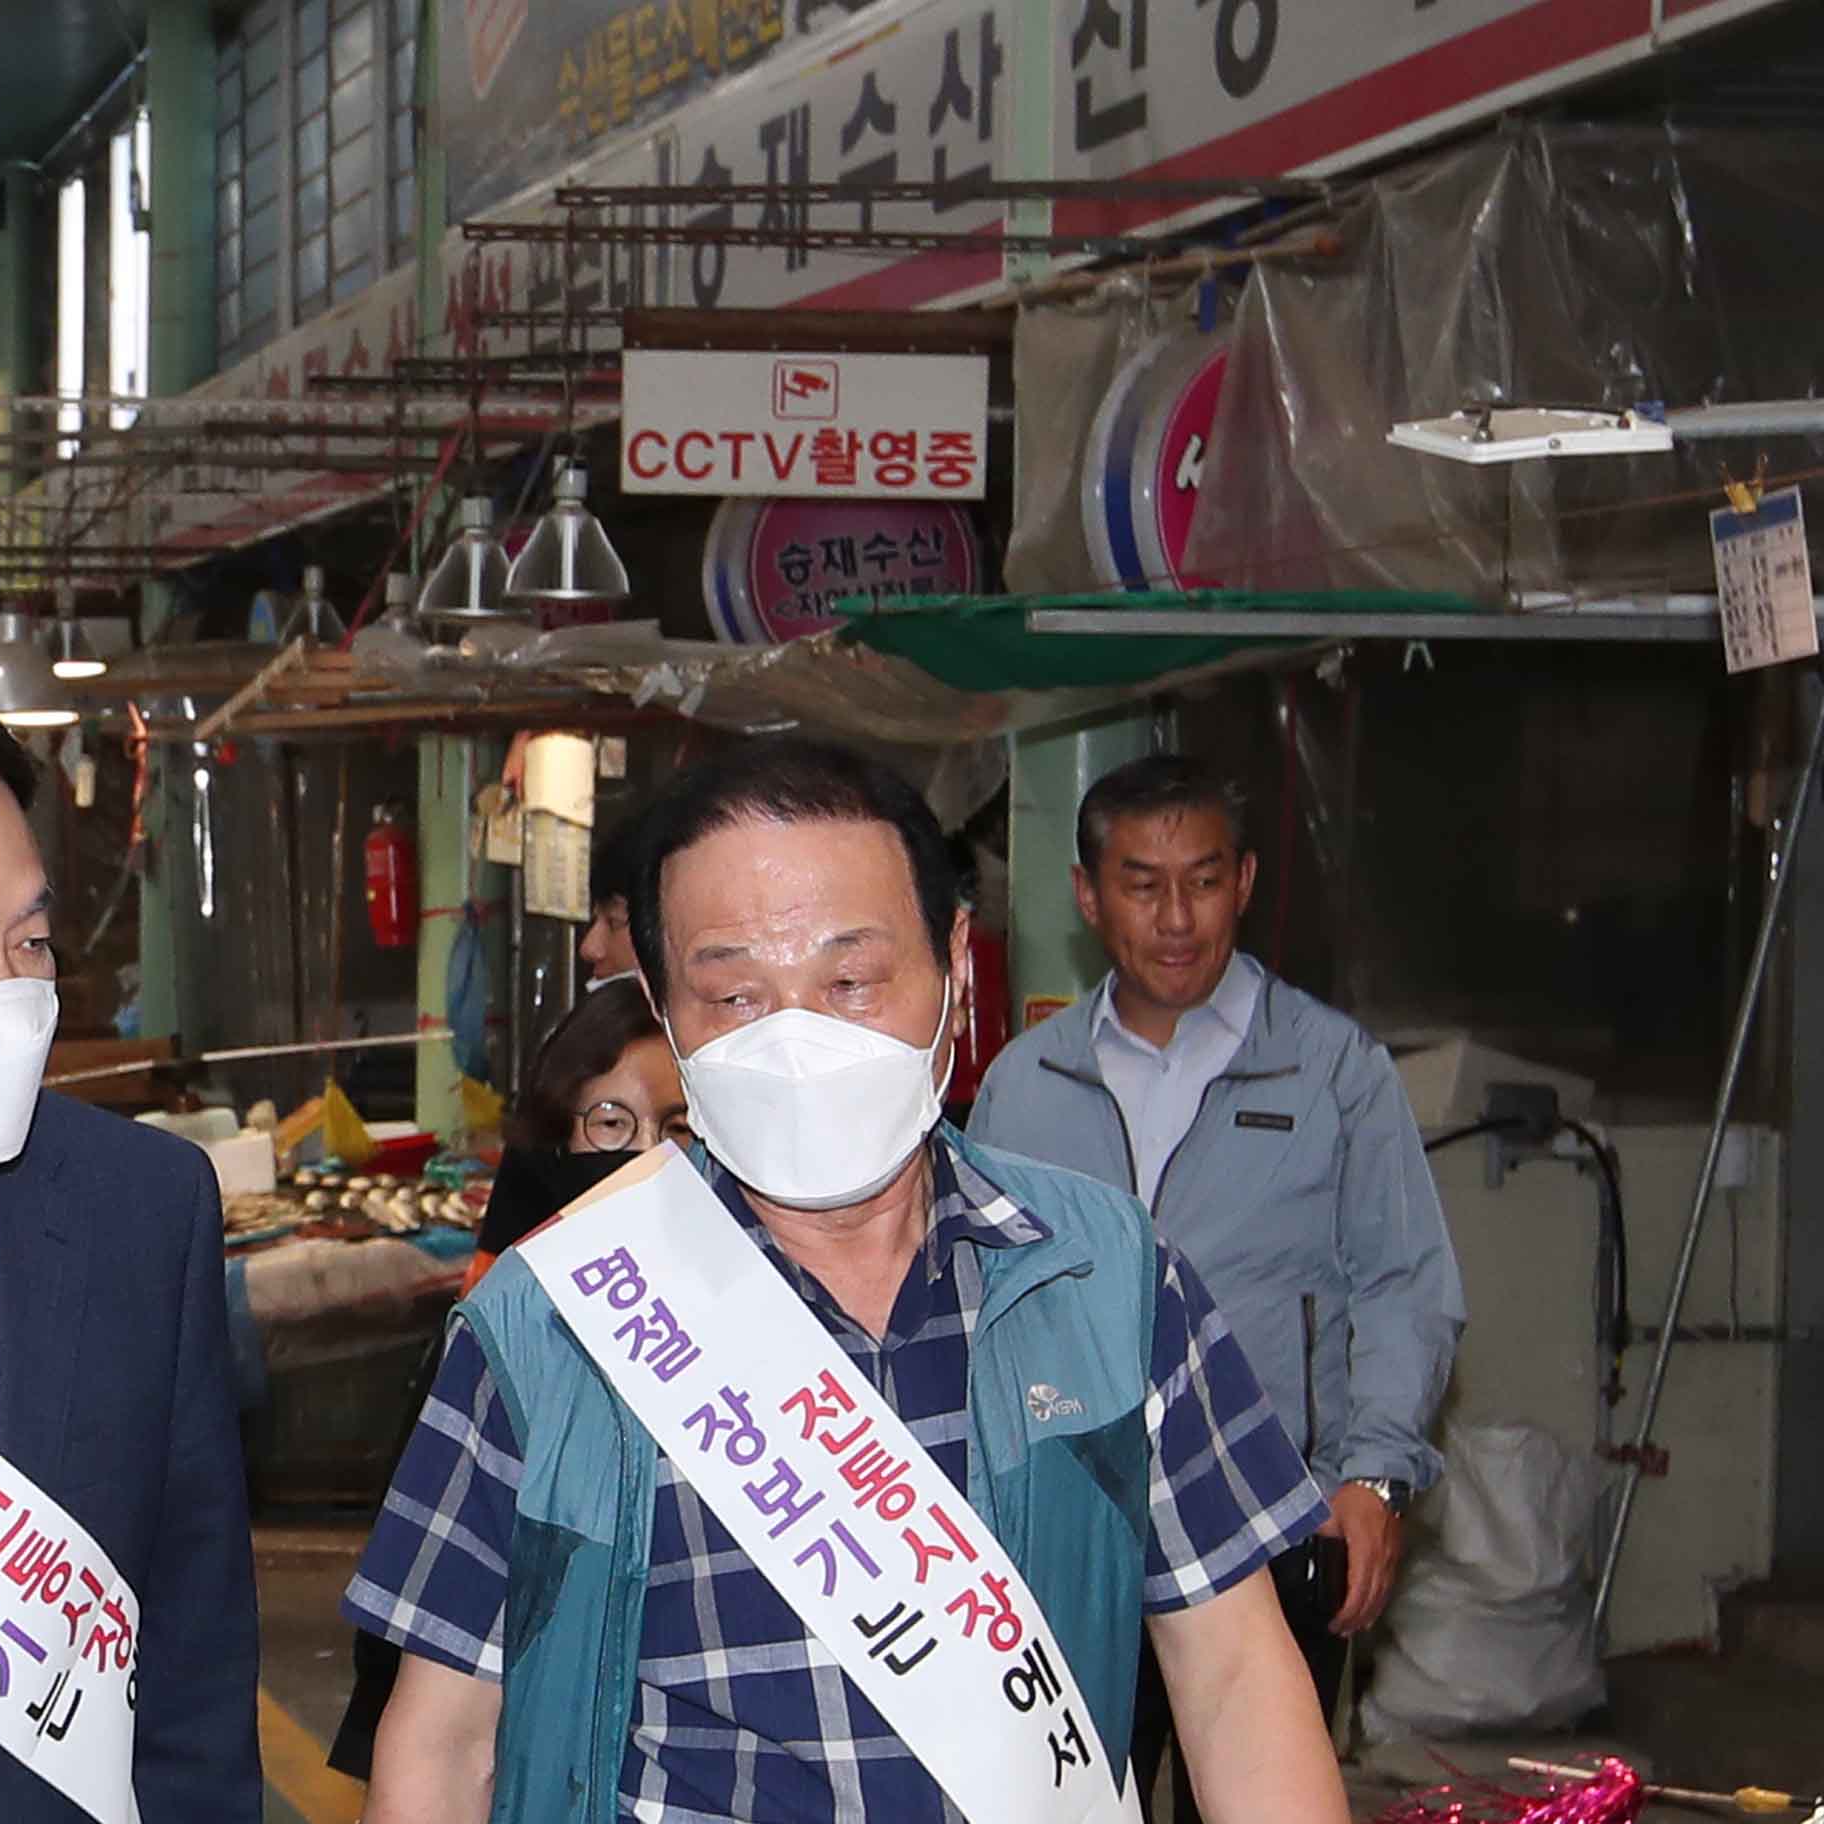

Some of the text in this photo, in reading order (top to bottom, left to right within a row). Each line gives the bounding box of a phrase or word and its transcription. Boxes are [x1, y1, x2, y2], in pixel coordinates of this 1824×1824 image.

[628, 429, 977, 488] CCTV촬영중
[571, 1246, 939, 1676] 명절 장보기는
[781, 1368, 1092, 1787] 전통시장에서
